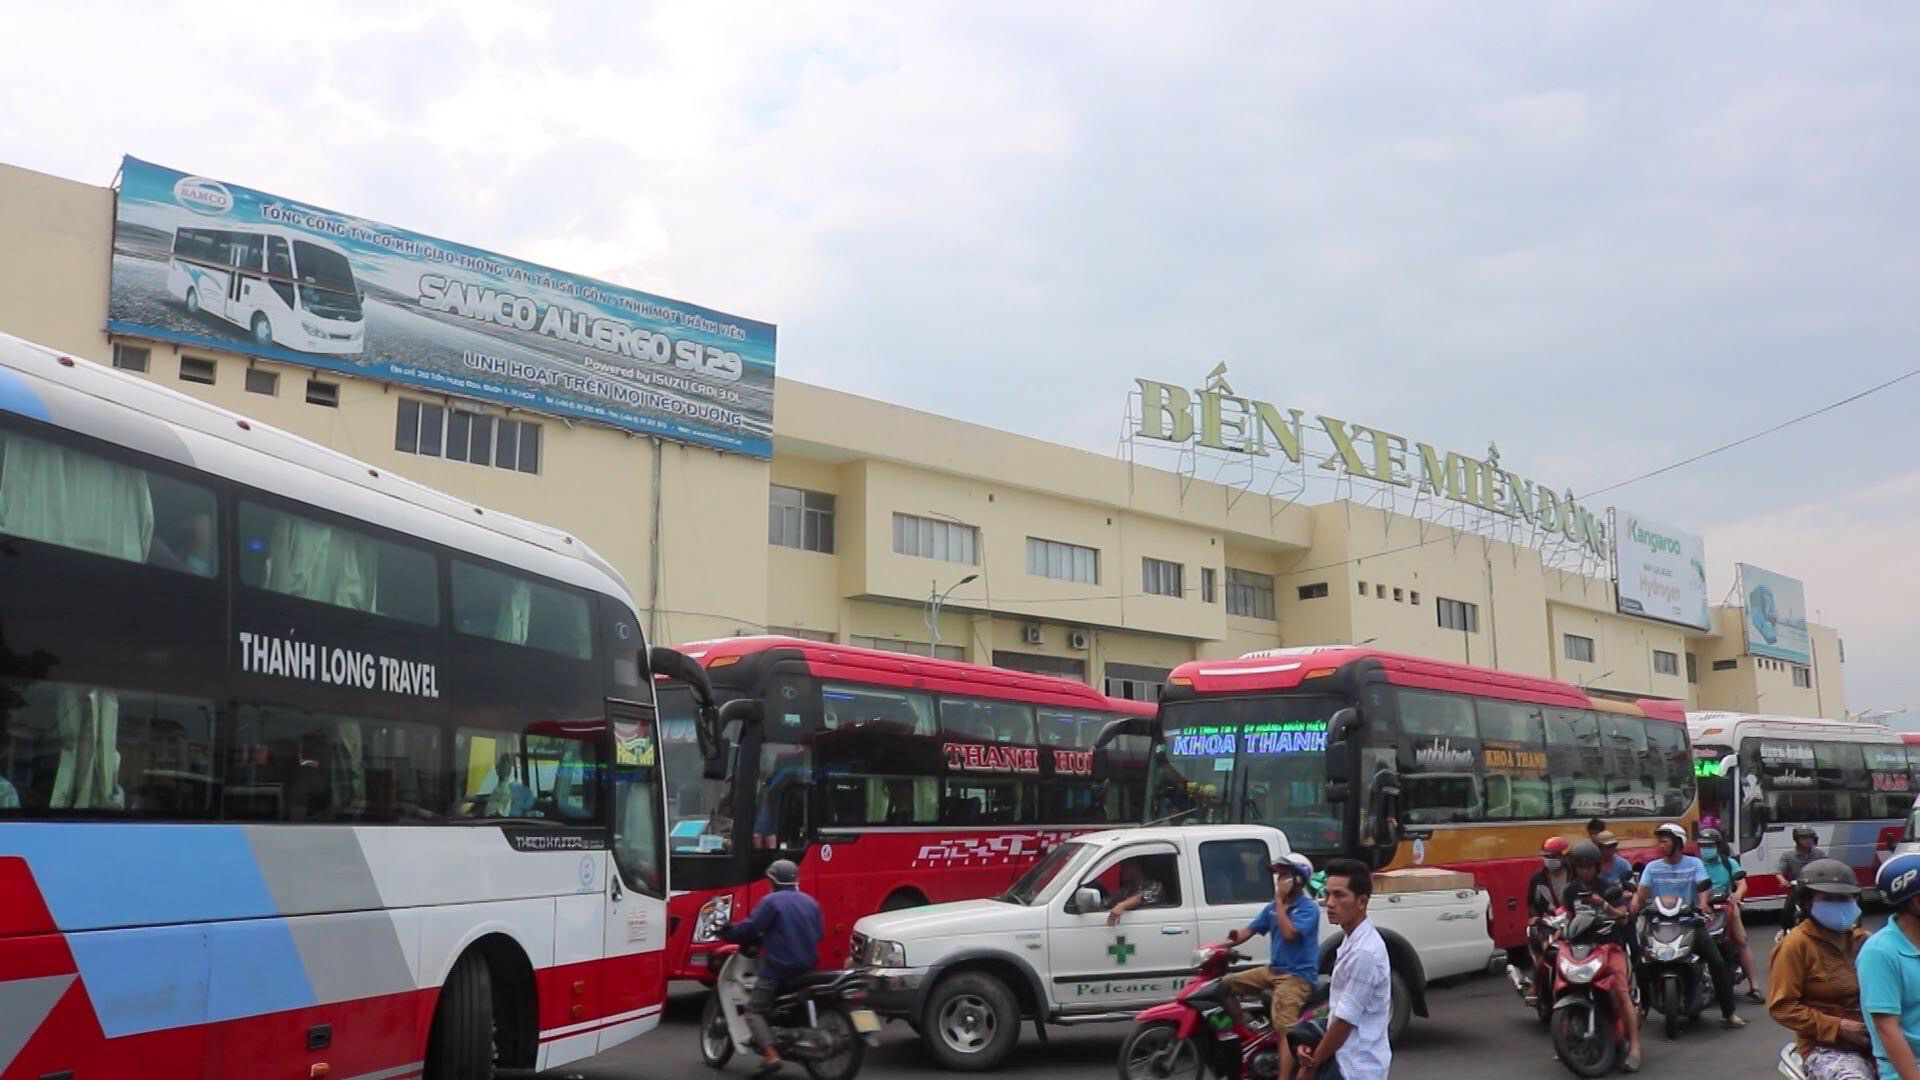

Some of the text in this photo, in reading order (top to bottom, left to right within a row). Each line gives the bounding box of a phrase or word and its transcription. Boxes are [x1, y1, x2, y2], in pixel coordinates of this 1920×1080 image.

[180, 187, 226, 205] SAMCO
[350, 227, 370, 242] TY
[426, 245, 455, 264] GIAO
[418, 273, 538, 331] SAMCO
[539, 304, 672, 365] ALLERGO
[463, 350, 506, 375] LINH
[584, 356, 634, 379] Powered
[636, 369, 650, 384] by
[652, 372, 689, 391] ISUZU
[1135, 360, 1304, 463] BẾN
[1316, 414, 1412, 487] XE
[1415, 440, 1536, 525] MIỀN
[1626, 517, 1681, 555] Kangaroo
[321, 646, 376, 690] LONG
[379, 655, 440, 699] TRAVEL
[943, 742, 1040, 774] THANH
[1173, 731, 1328, 755] KHOA THANH
[1891, 868, 1918, 893] GP
[1076, 981, 1164, 997] Petcare
